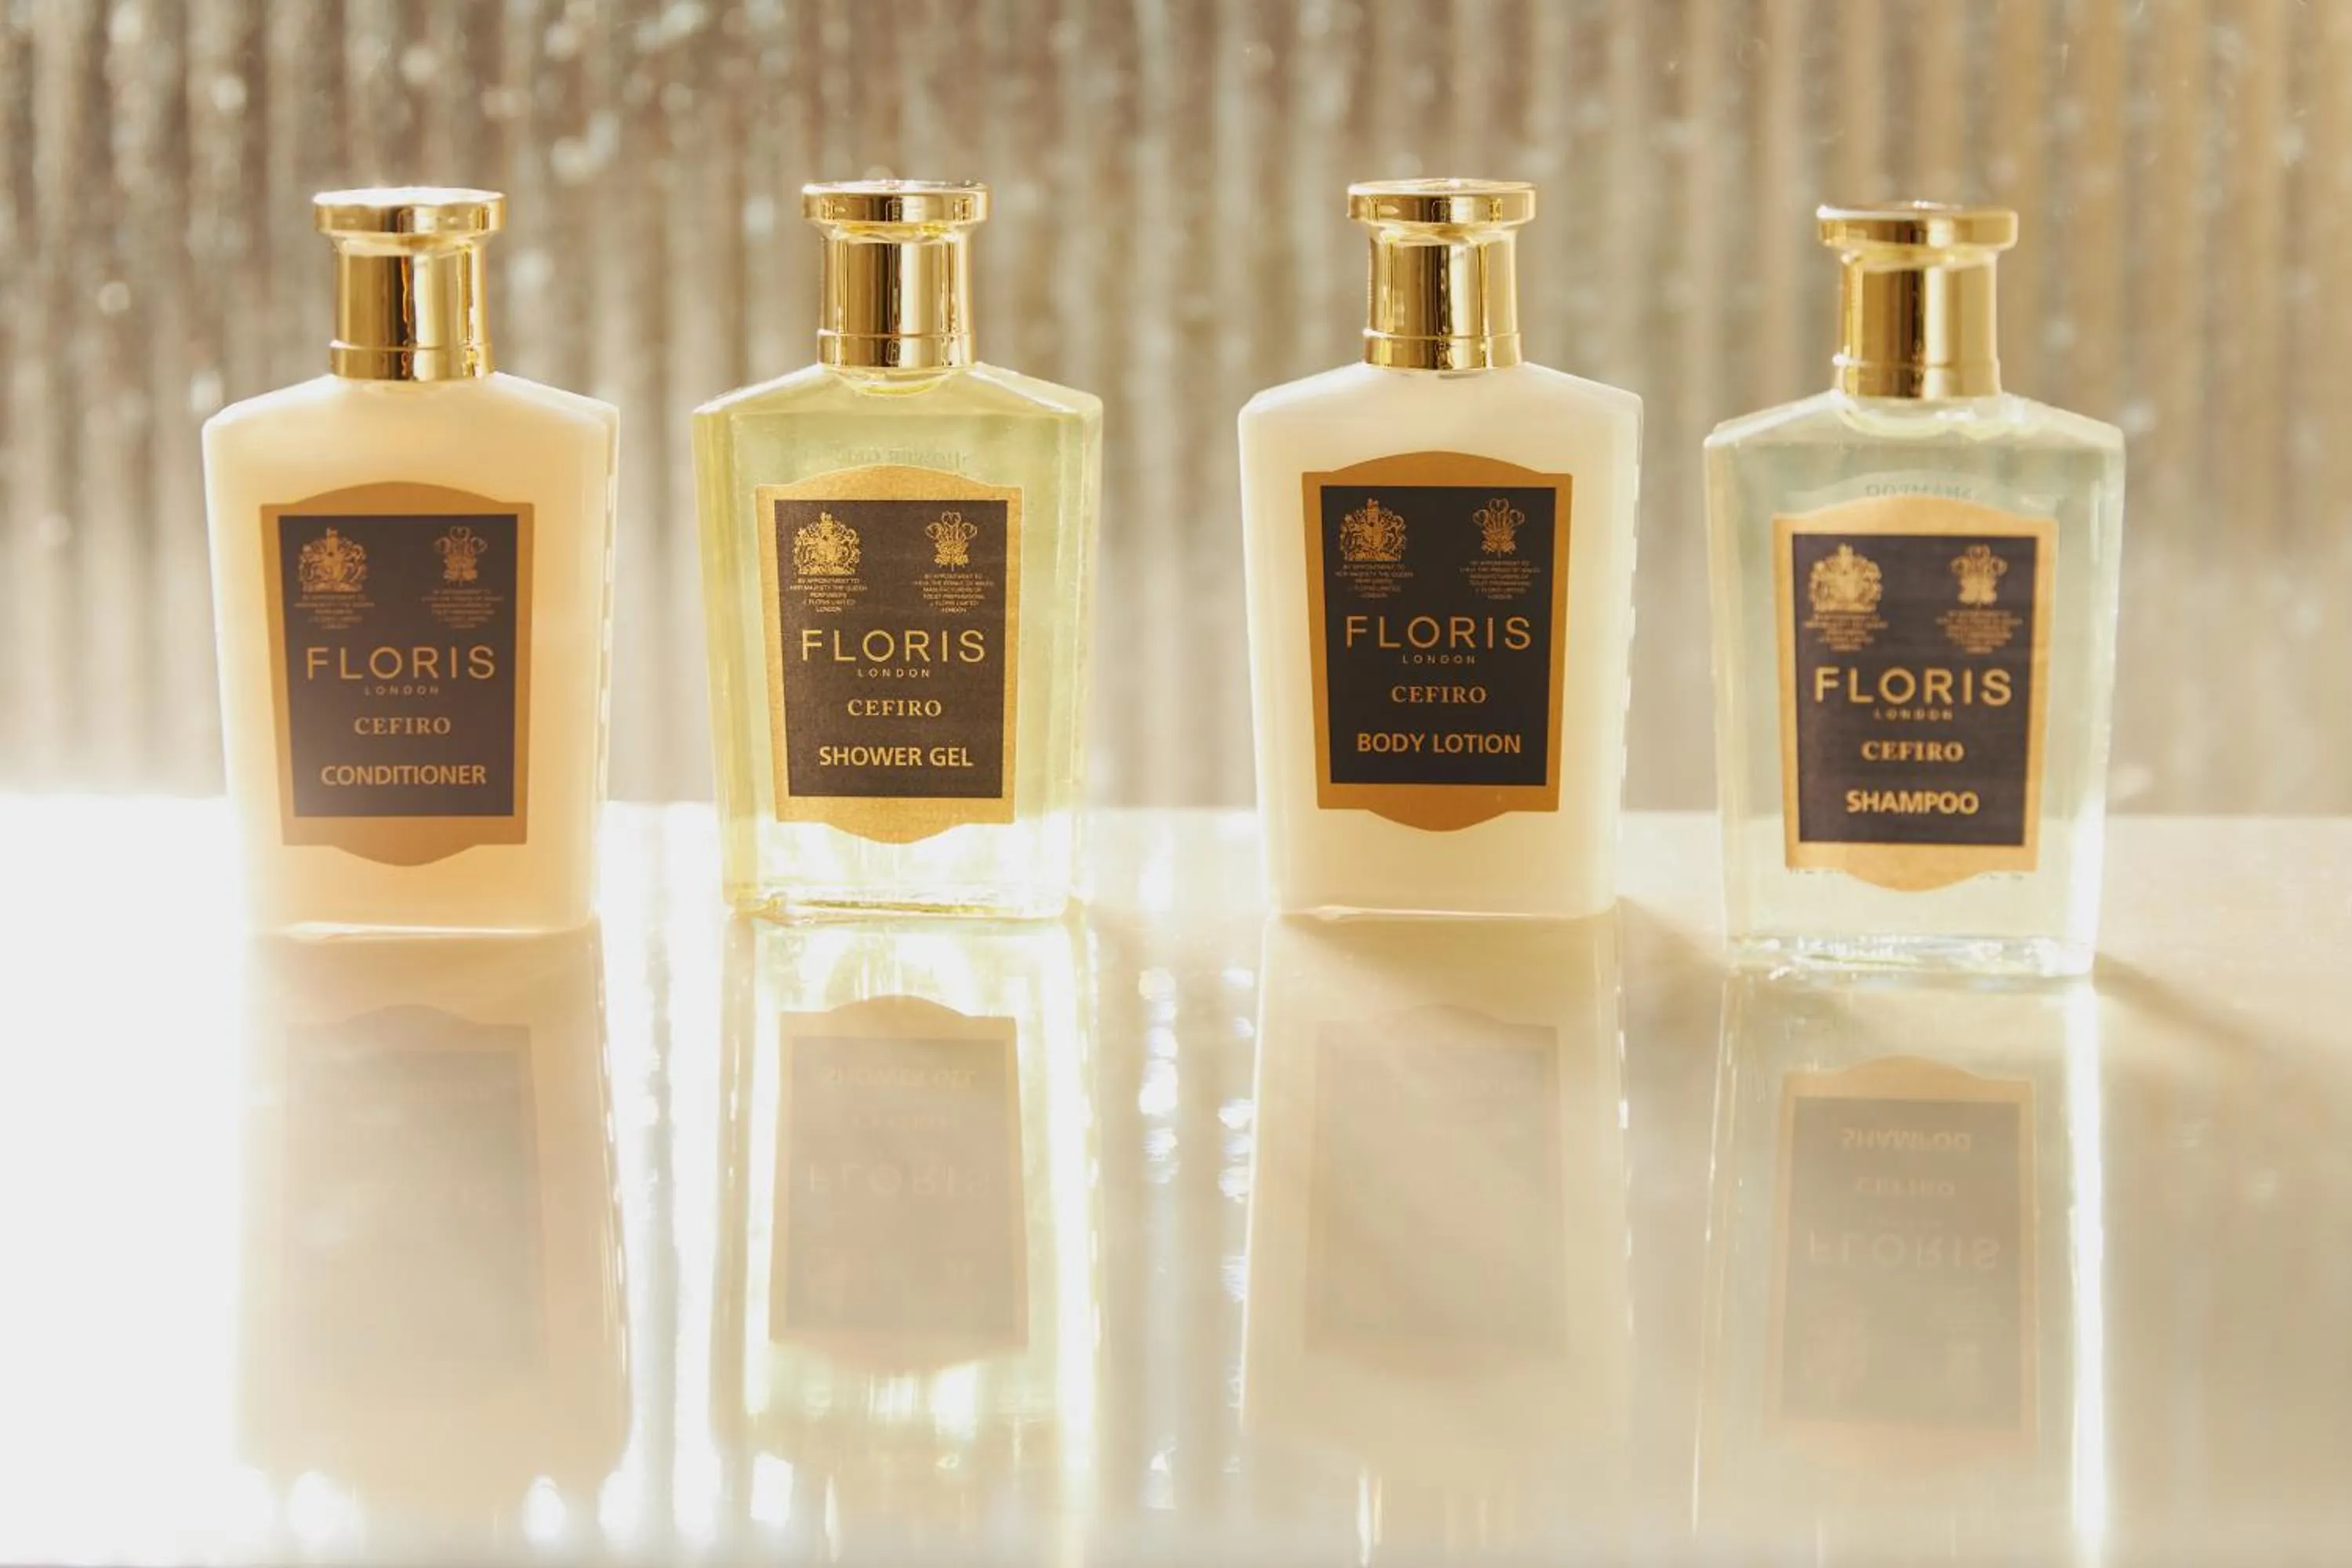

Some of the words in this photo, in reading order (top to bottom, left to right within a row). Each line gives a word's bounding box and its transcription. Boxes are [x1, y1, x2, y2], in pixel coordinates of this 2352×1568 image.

[1347, 616, 1532, 651] FLORIS
[800, 630, 985, 663] FLORIS
[306, 646, 495, 682] FLORIS
[1403, 655, 1476, 666] LONDON
[858, 668, 931, 679] LONDON
[365, 685, 440, 697] LONDON
[1392, 686, 1487, 704] CEFIRO
[1814, 666, 2013, 707] FLORIS
[848, 700, 942, 718] CEFIRO
[1875, 709, 1954, 722] LONDON
[354, 717, 452, 736] CEFIRO
[1358, 733, 1426, 753] BODY
[1433, 734, 1522, 754] LOTION
[1862, 742, 1965, 763] CEFIRO
[819, 746, 924, 767] SHOWER
[930, 748, 975, 768] GEL
[321, 764, 487, 786] CONDITIONER
[1846, 790, 1980, 815] SHAMPOO
